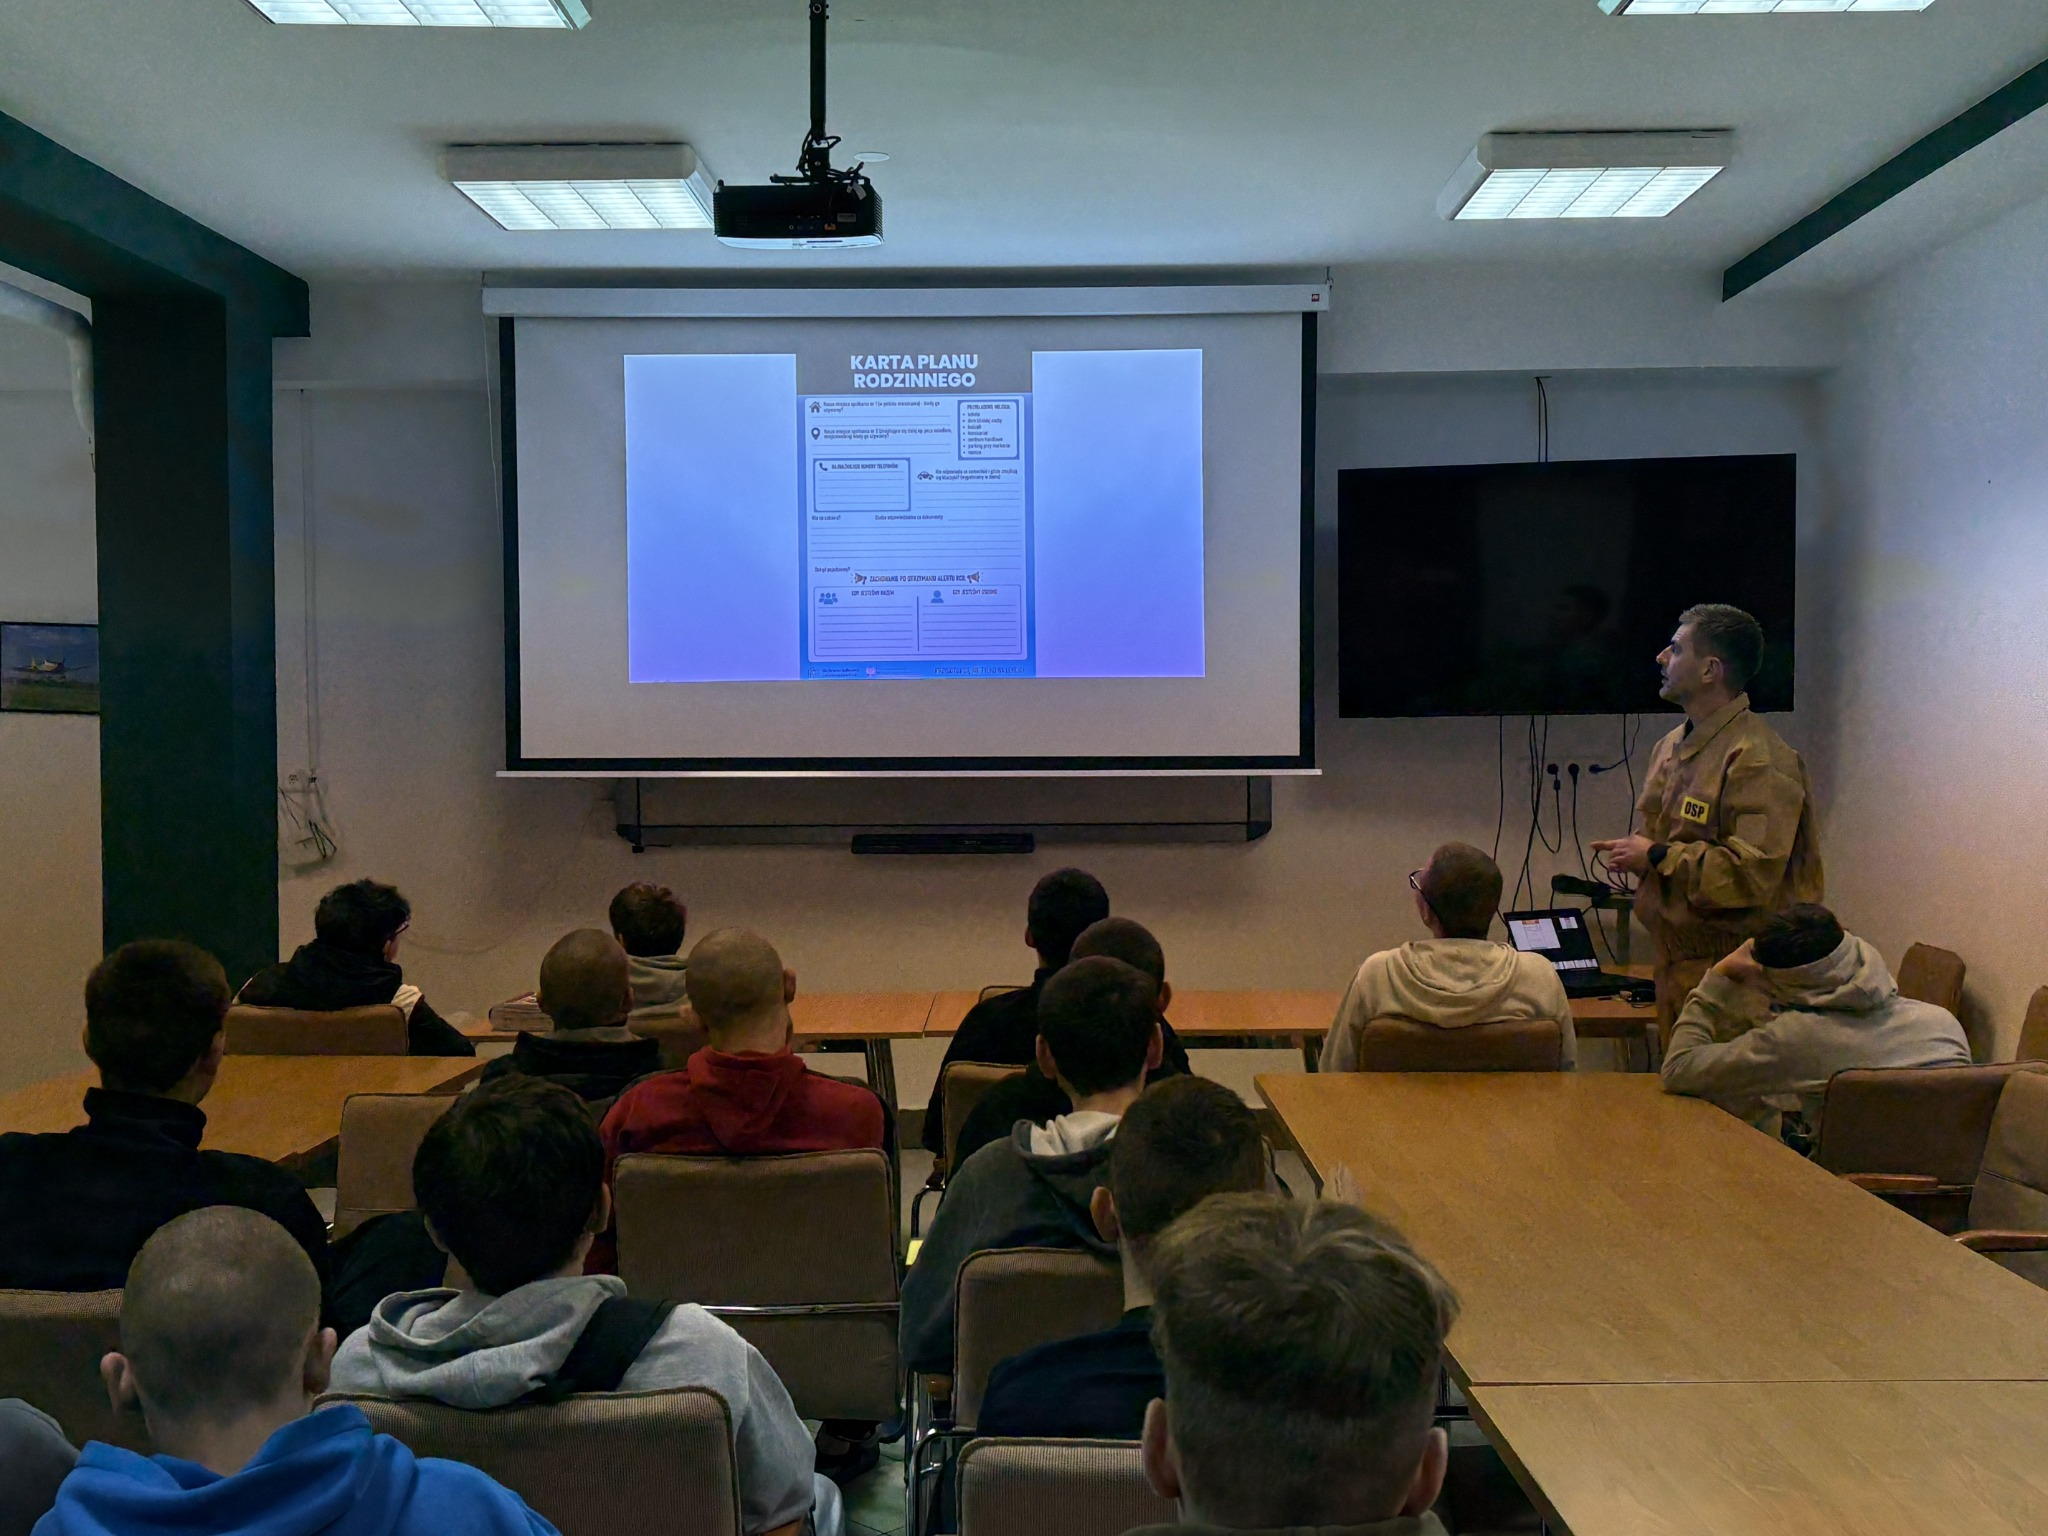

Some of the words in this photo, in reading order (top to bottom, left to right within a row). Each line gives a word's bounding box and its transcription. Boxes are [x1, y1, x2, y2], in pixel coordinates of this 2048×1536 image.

[850, 355, 915, 370] KARTA
[917, 354, 979, 369] PLANU
[853, 373, 976, 388] RODZINNEGO
[1684, 801, 1705, 818] OSP
